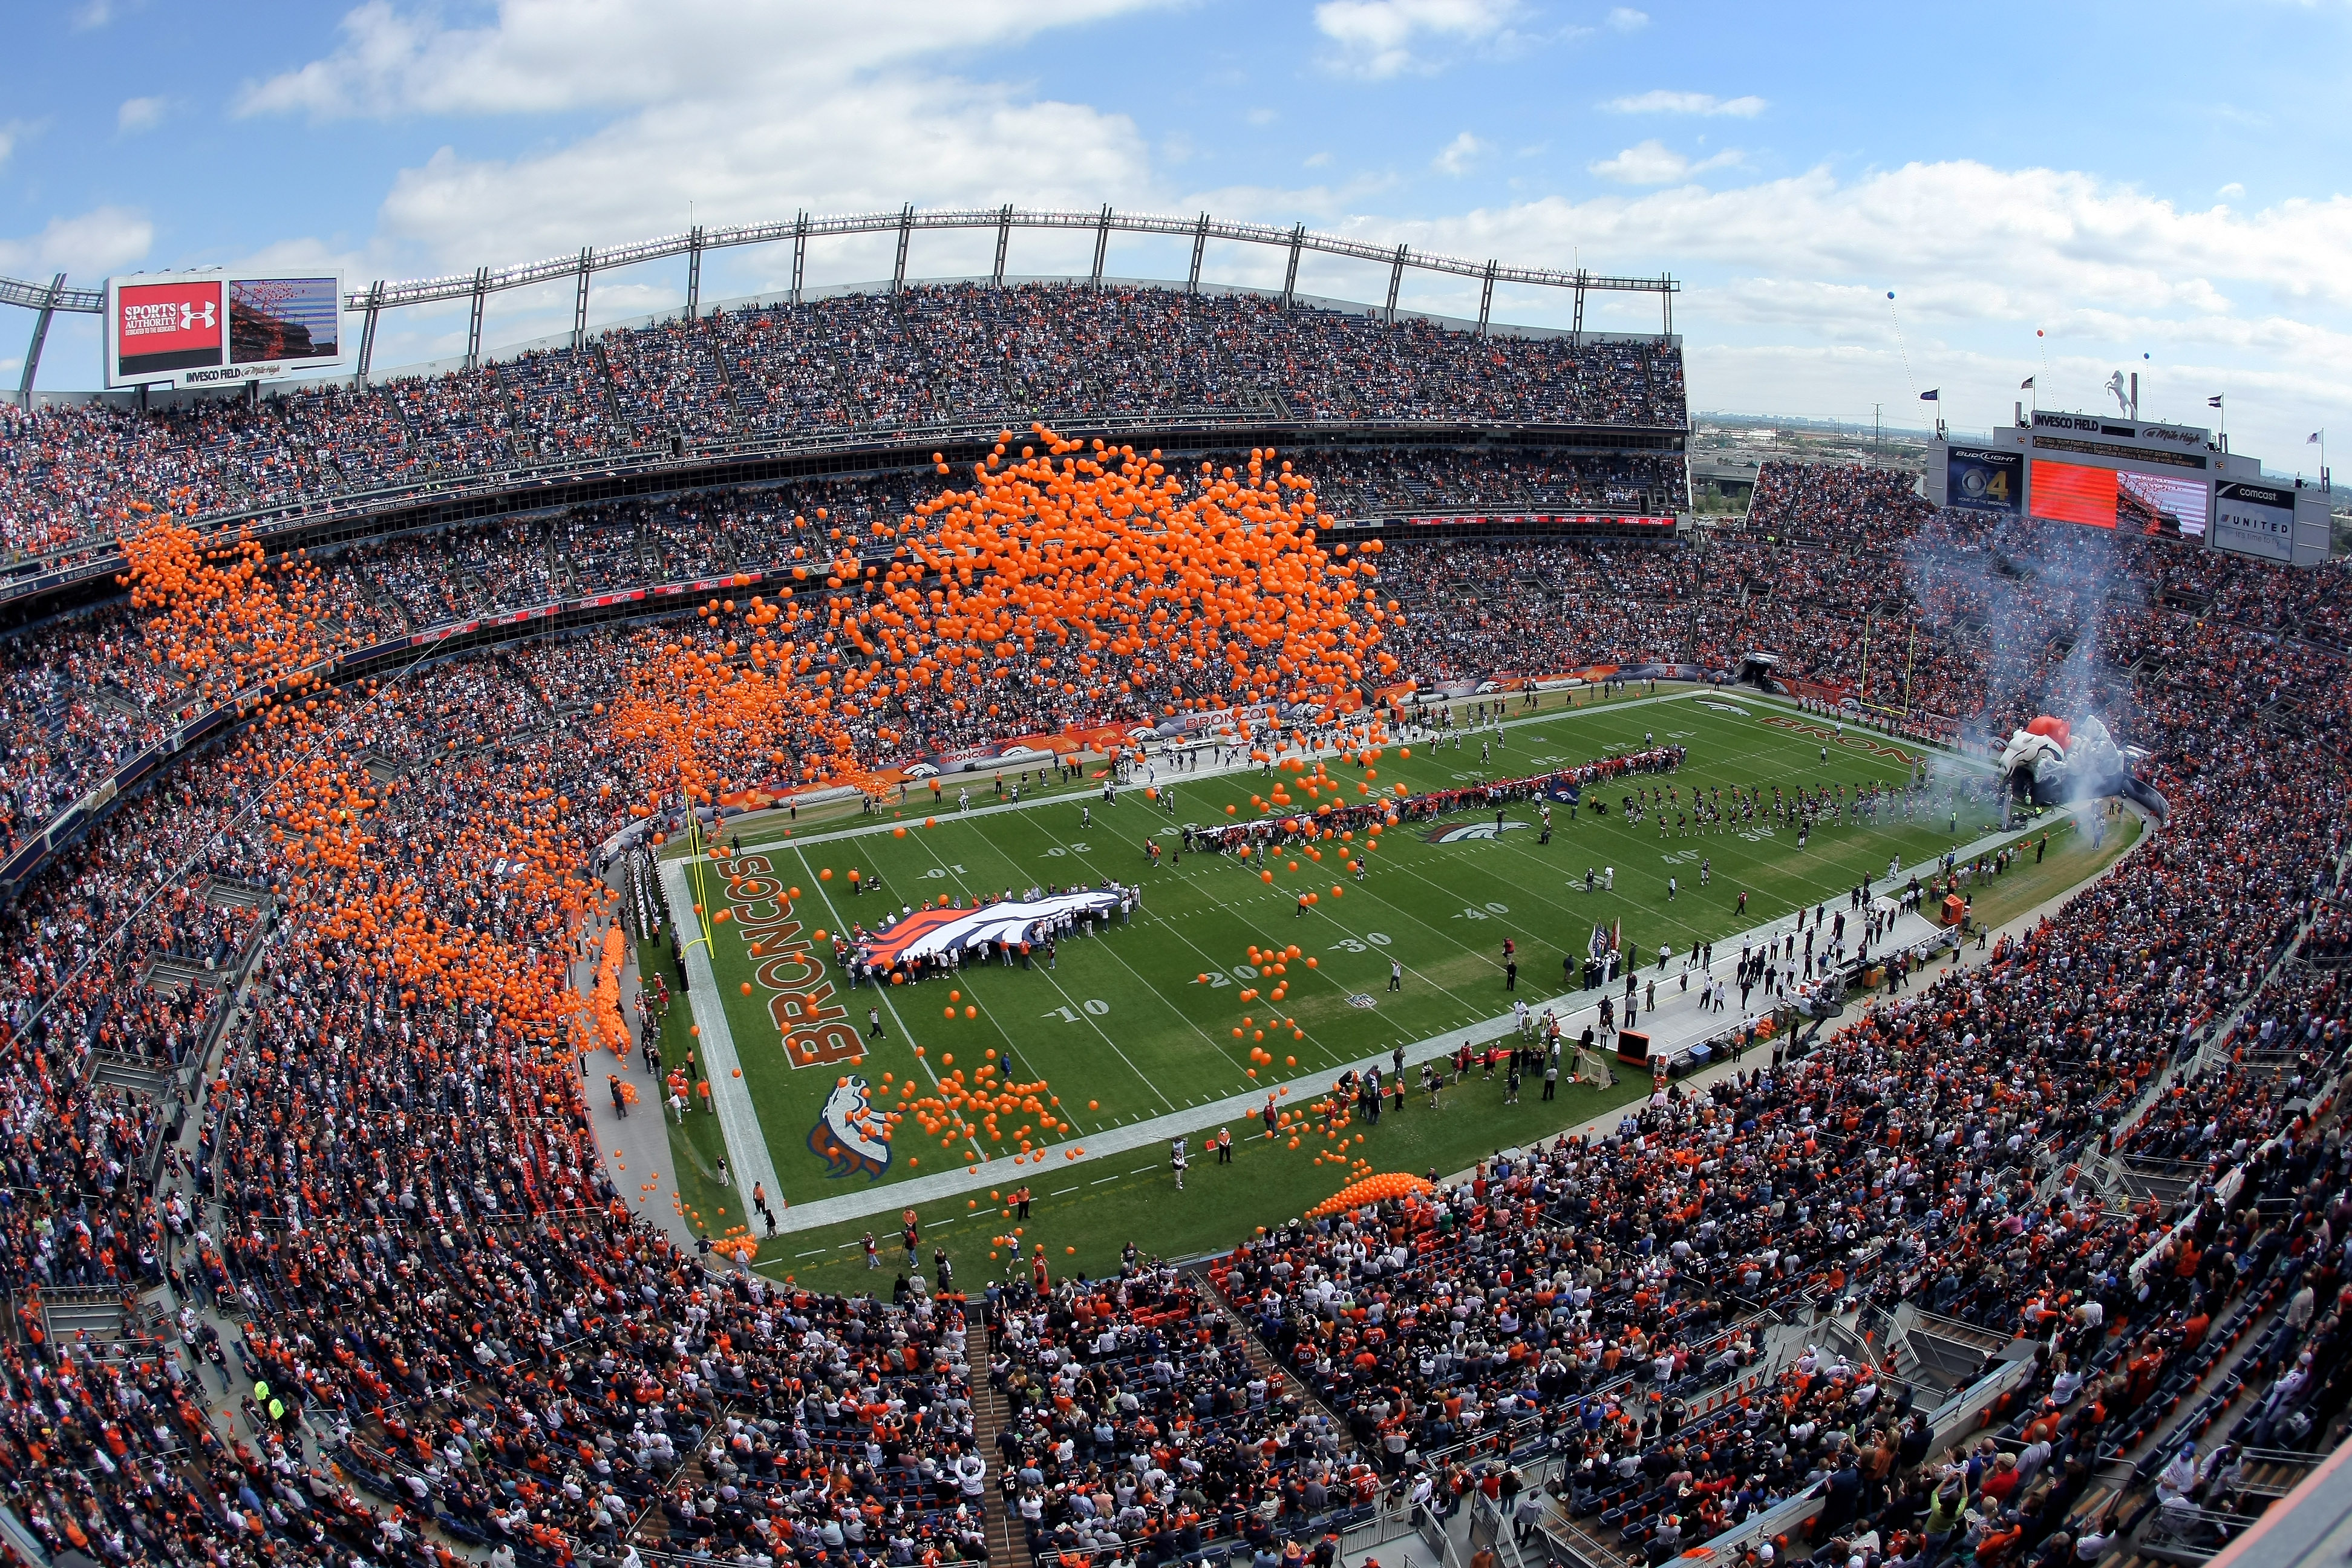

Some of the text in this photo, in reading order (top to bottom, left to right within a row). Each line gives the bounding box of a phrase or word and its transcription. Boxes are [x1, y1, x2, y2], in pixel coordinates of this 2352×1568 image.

[125, 303, 176, 321] SPORTS
[125, 317, 176, 329] AUTHORITY
[186, 370, 219, 383] INVESCO
[220, 368, 241, 379] FIELD
[2034, 414, 2073, 430] INVESCO
[2074, 419, 2099, 431] FIELD
[2157, 428, 2178, 441] Mile
[2178, 433, 2201, 446] High
[1986, 471, 2009, 501] 4
[2239, 488, 2277, 501] comcast
[367, 500, 416, 514] GERALD PHIPPS
[285, 520, 302, 529] GOOSE
[304, 514, 333, 525] GONSOULIN
[2233, 516, 2288, 533] UNITED
[2247, 533, 2261, 542] time
[74, 569, 87, 579] FLOYD
[88, 566, 101, 575] LITTLE
[1, 589, 15, 600] ELWAY
[1663, 665, 1678, 678] A
[1435, 680, 1476, 691] BRONCOS
[1184, 707, 1267, 730] BRONCO
[939, 748, 995, 765] BRONCOS
[1662, 849, 1700, 865] 40
[927, 862, 969, 880] 10
[1463, 903, 1510, 921] 40
[1341, 932, 1392, 953] 30
[715, 855, 869, 1070] BRONCOS
[1201, 965, 1259, 988] 20
[1055, 998, 1109, 1023] 10
[1697, 1264, 1707, 1275] 87
[1369, 1336, 1380, 1345] 27
[1271, 1380, 1282, 1390] 80
[1759, 1460, 1768, 1470] 6
[1005, 1481, 1016, 1491] 16
[1363, 1483, 1376, 1495] 77
[904, 1520, 916, 1532] 56
